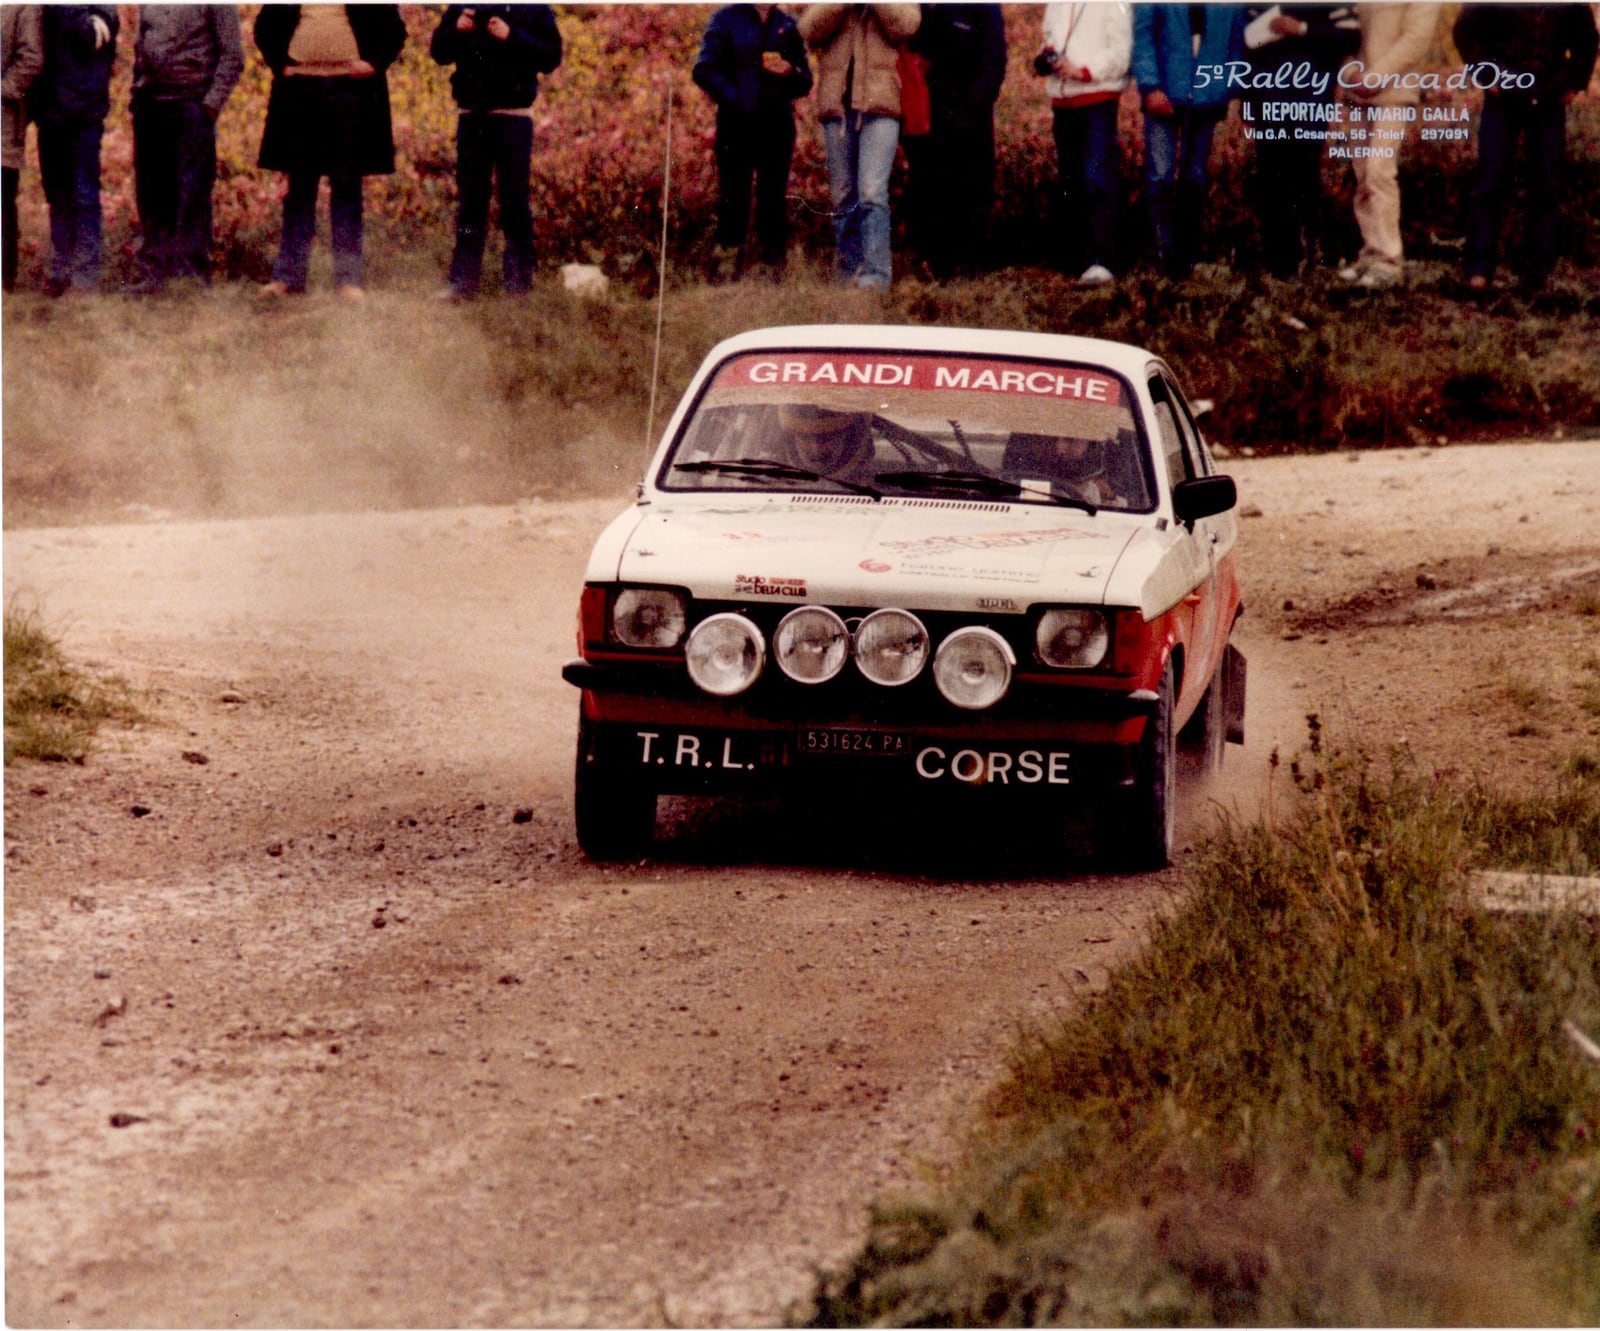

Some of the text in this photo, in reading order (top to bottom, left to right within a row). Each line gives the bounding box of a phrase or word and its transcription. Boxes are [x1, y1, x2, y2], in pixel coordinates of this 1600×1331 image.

[749, 361, 1110, 401] GRANDI MARCHE
[636, 731, 755, 770] T.R.L.
[808, 731, 903, 750] 531624 PA
[915, 746, 1071, 784] CORSE
